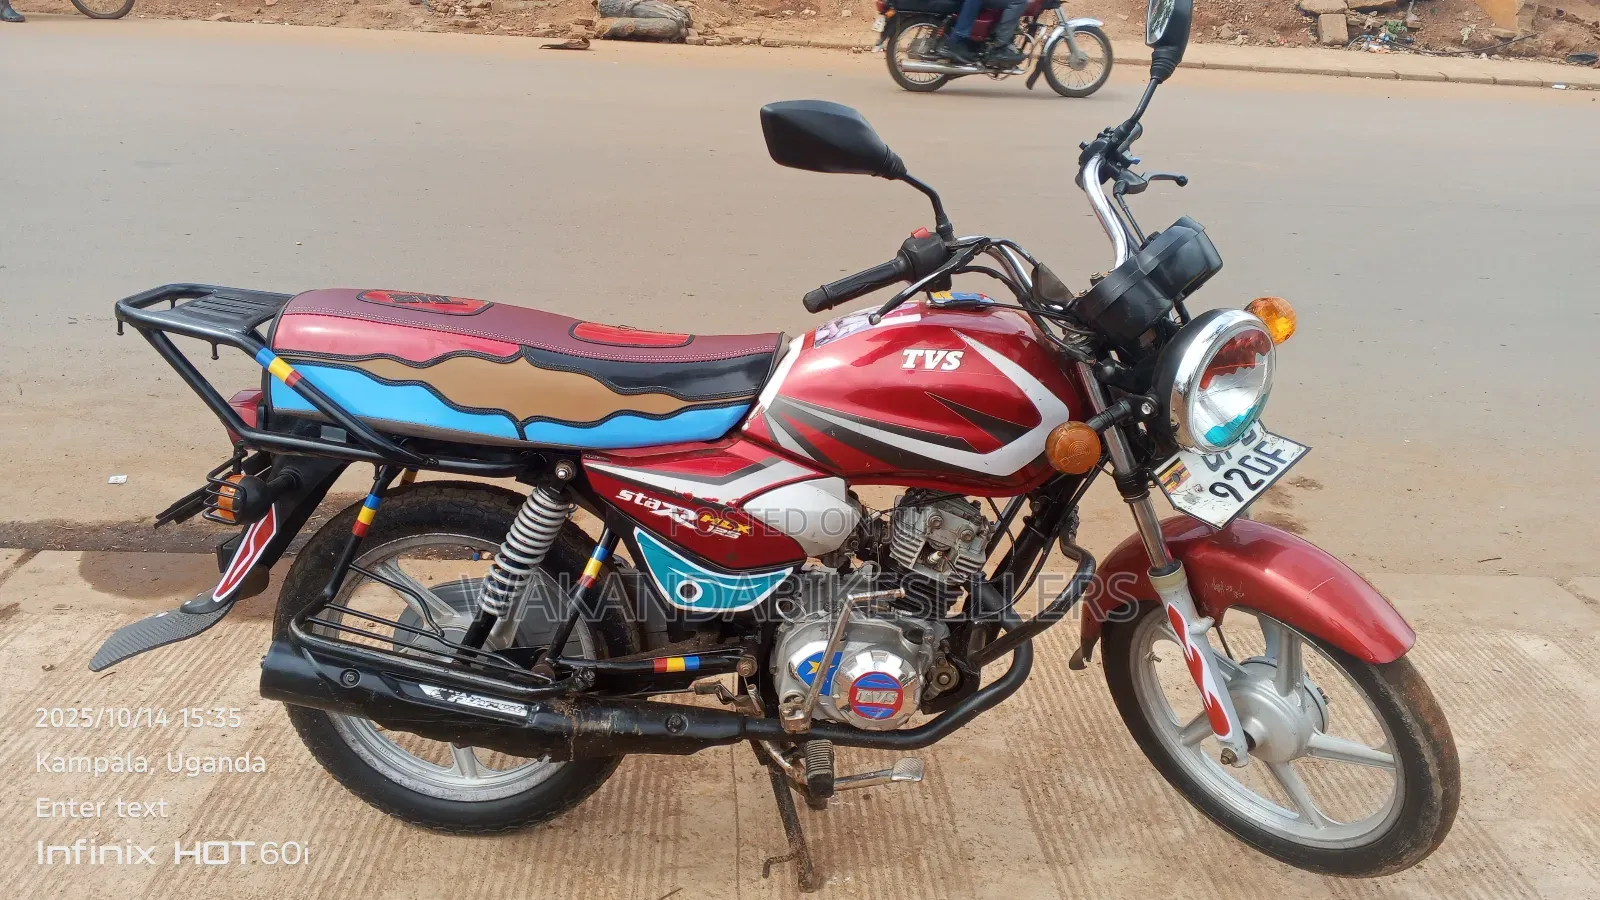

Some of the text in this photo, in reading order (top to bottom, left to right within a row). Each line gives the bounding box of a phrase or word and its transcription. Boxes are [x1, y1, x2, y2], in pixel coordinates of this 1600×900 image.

[901, 349, 965, 371] TVS
[1208, 440, 1288, 503] 920F
[707, 524, 741, 540] 125
